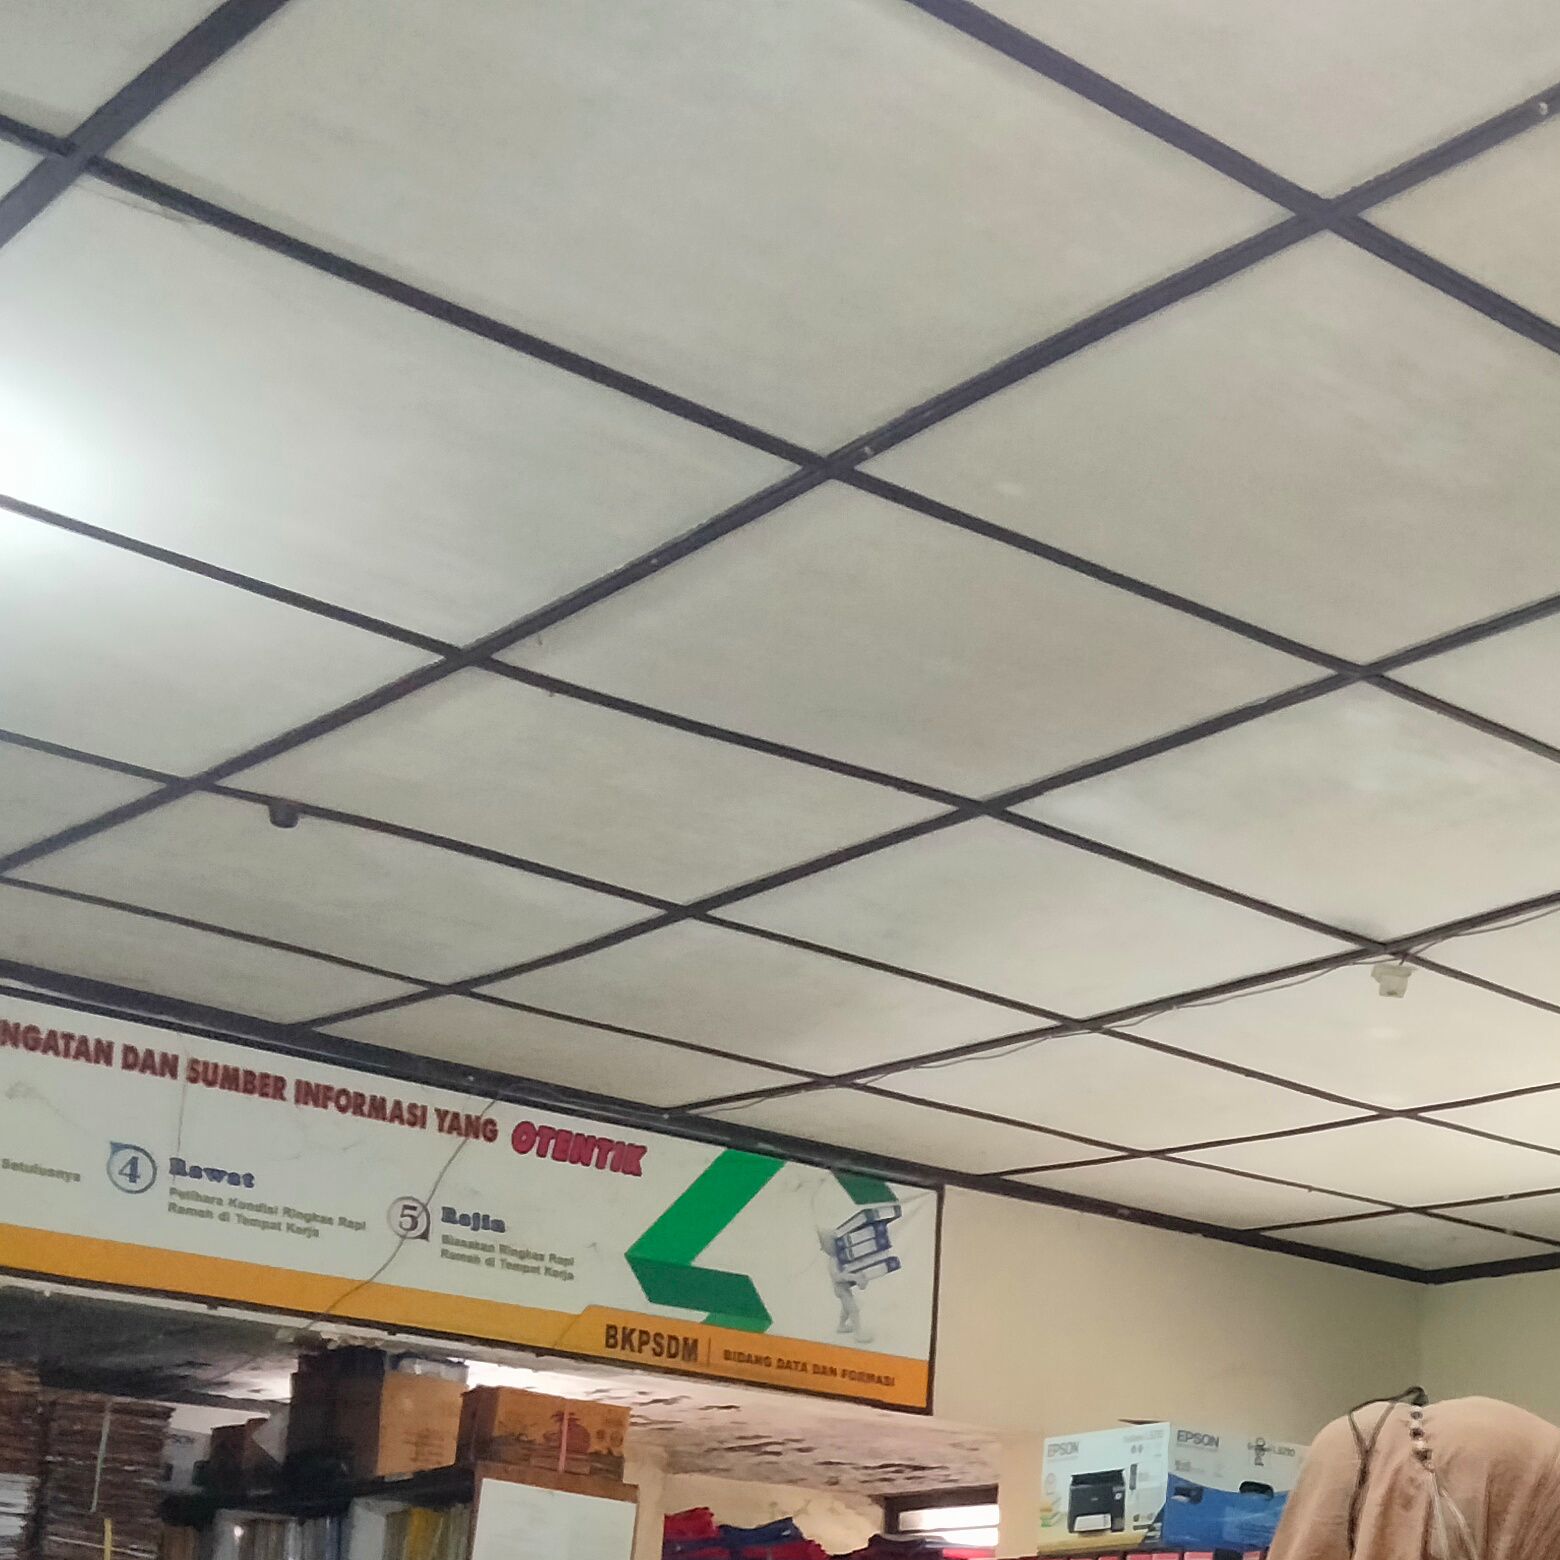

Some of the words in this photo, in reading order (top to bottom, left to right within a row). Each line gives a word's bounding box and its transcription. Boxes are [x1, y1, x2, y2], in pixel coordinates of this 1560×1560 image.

[121, 1043, 179, 1080] DAN
[186, 1057, 287, 1101] SUMBER
[294, 1078, 427, 1130] INFORMASI
[434, 1107, 498, 1143] YANG
[511, 1120, 647, 1177] OTENTIK
[118, 1156, 141, 1184] 4
[169, 1157, 255, 1189] Rawat
[218, 1210, 230, 1222] di
[398, 1203, 419, 1232] 5
[605, 1323, 699, 1364] BKPSDM
[723, 1348, 772, 1370] BIDANG
[776, 1357, 808, 1375] DATA
[812, 1362, 838, 1378] DAN
[841, 1367, 897, 1388] FORMASI
[1047, 1440, 1080, 1459] EPSON
[1176, 1428, 1219, 1449] EPSON
